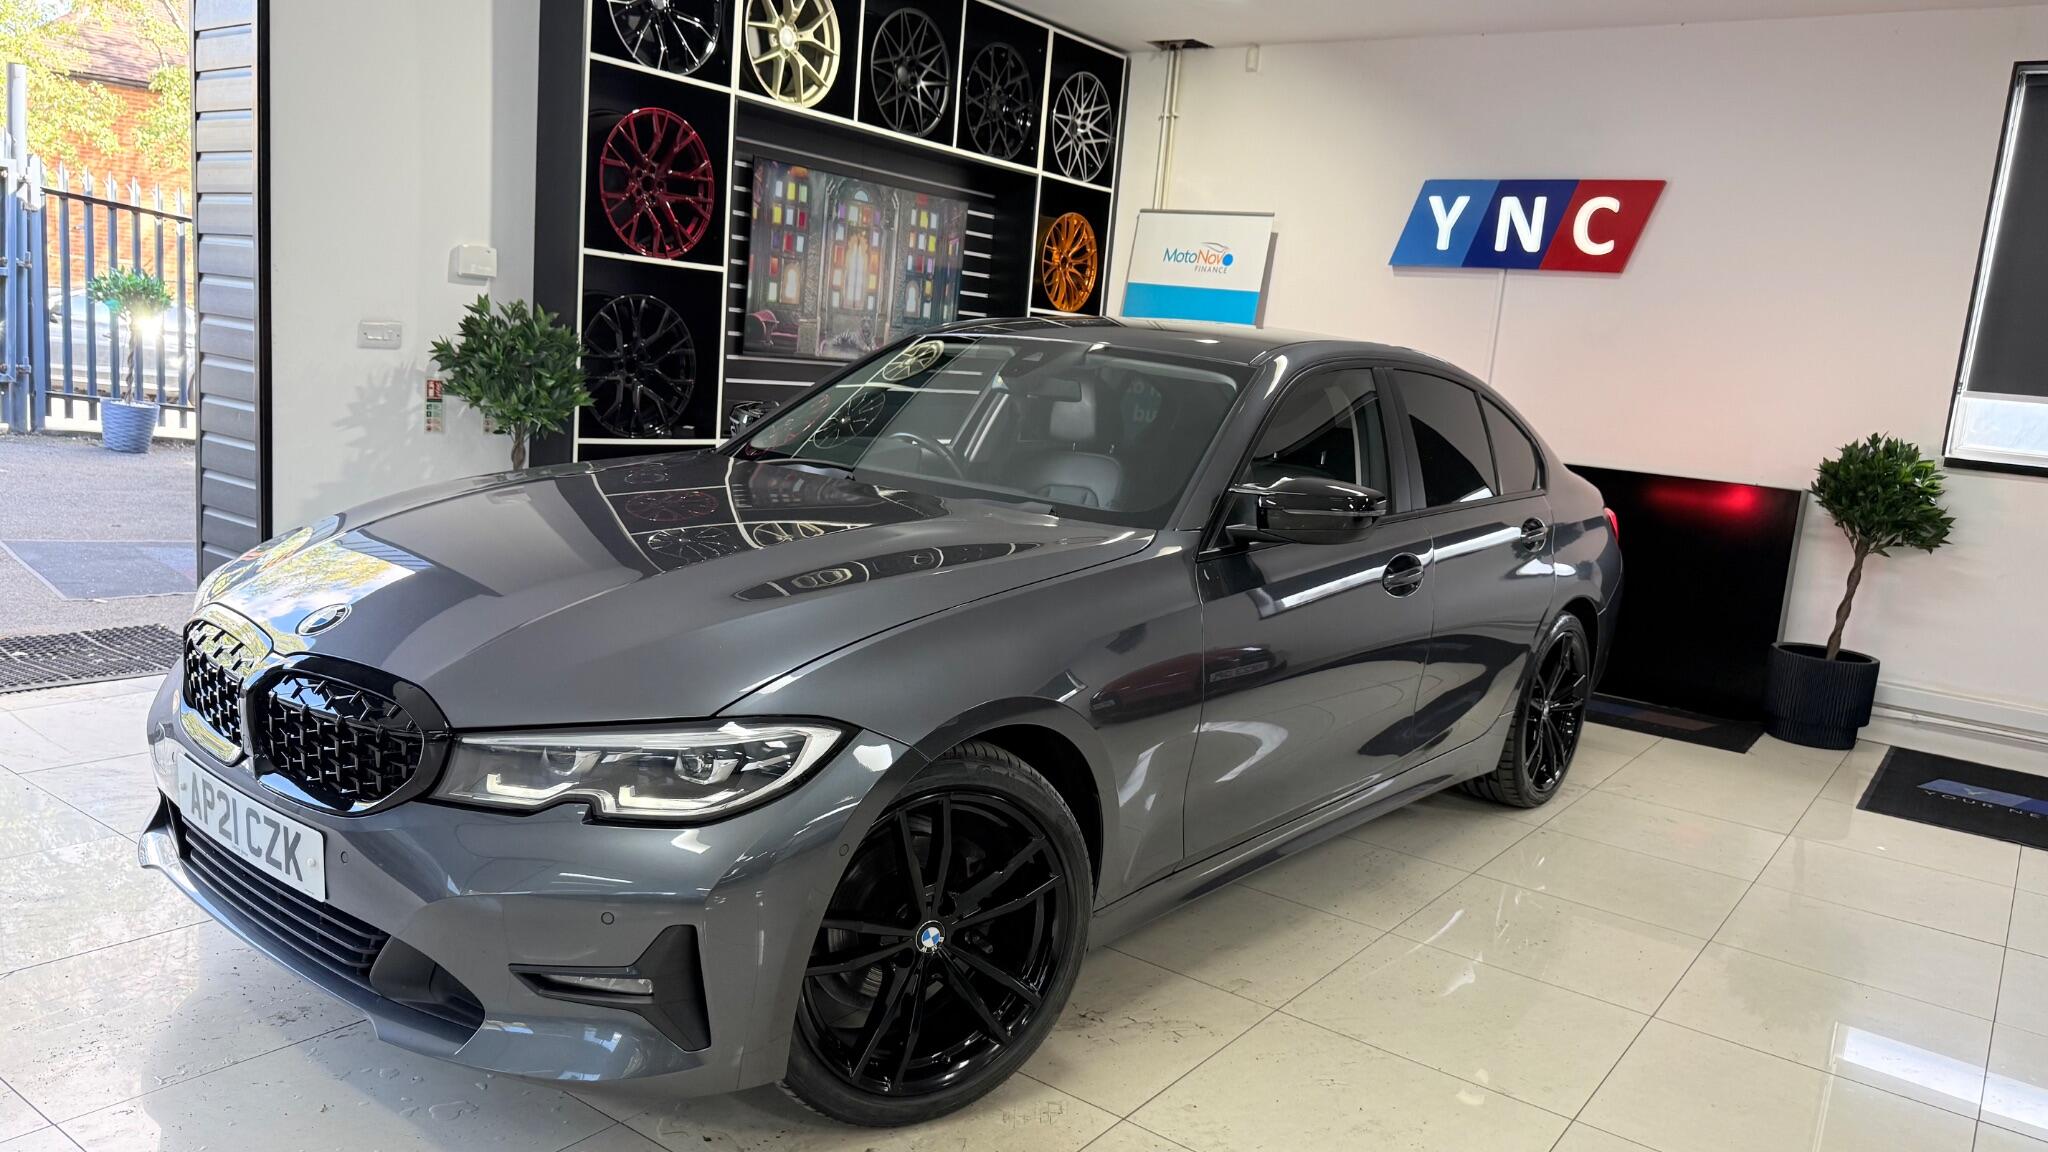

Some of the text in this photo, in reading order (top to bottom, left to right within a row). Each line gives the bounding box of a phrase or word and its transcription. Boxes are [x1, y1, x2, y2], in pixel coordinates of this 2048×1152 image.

[1428, 195, 1620, 256] YNC
[1194, 266, 1228, 275] FINANCE
[191, 771, 303, 882] AP21 CZK
[1924, 790, 2048, 821] YOUR NE
